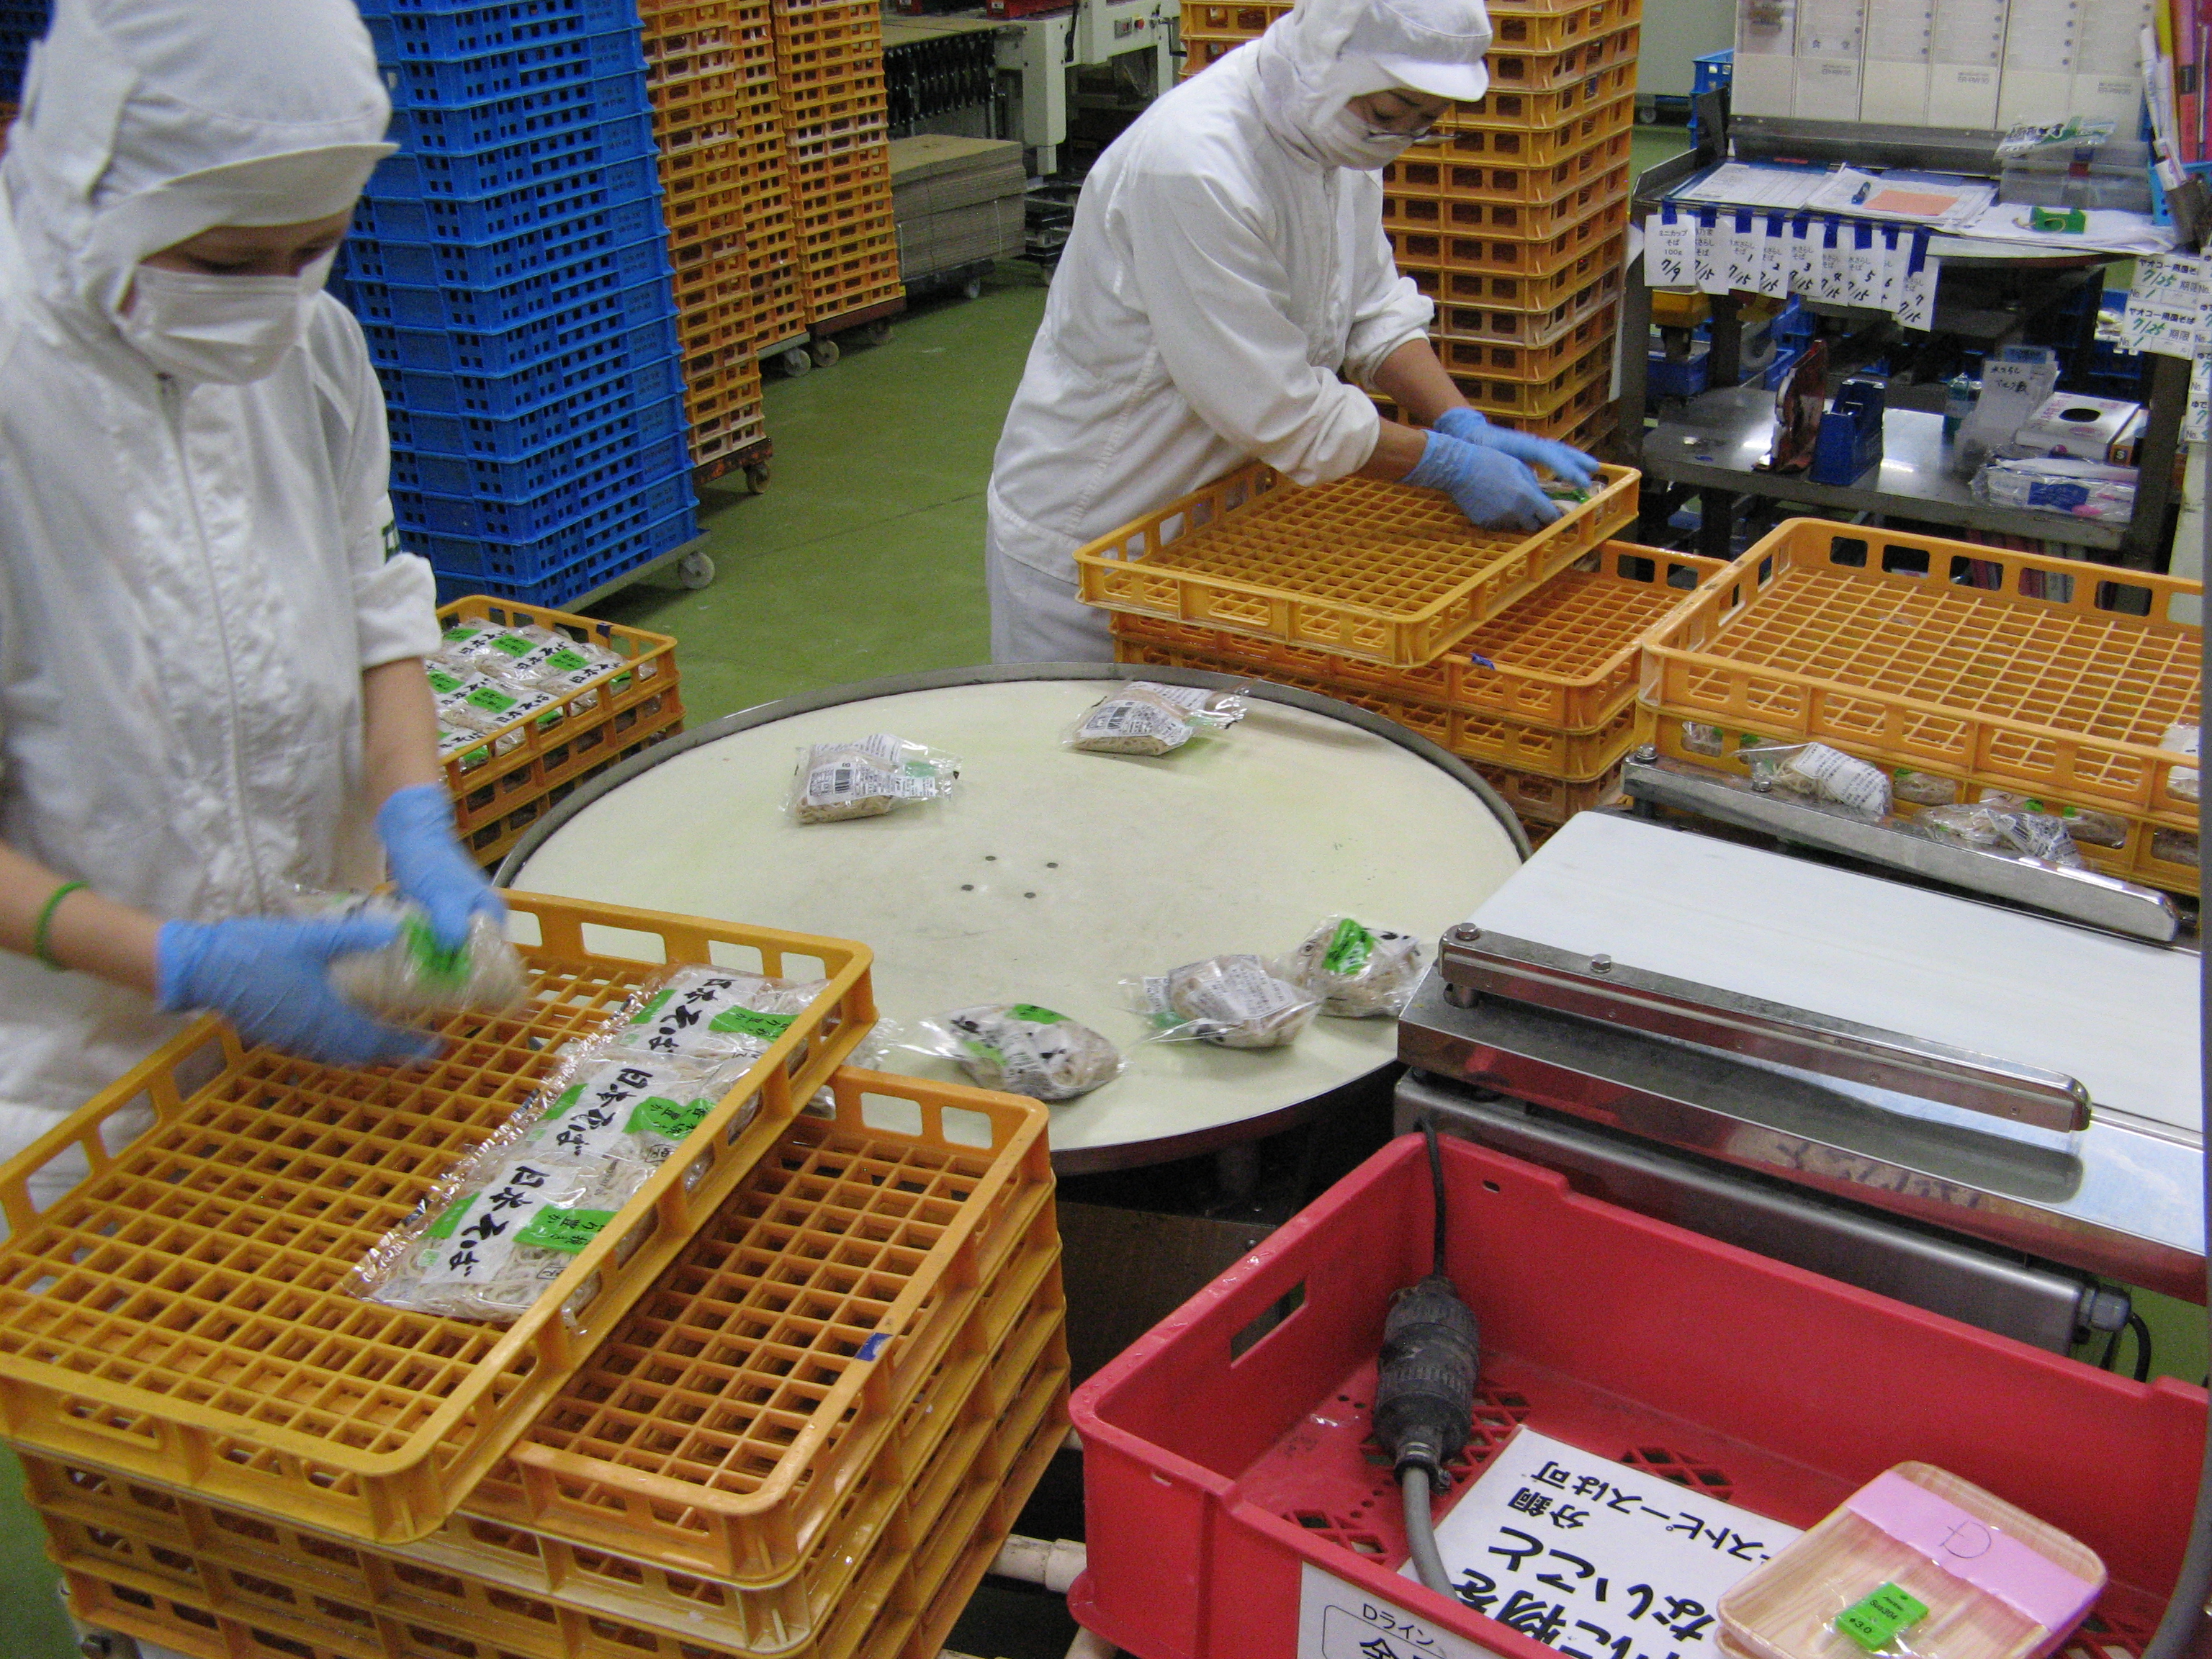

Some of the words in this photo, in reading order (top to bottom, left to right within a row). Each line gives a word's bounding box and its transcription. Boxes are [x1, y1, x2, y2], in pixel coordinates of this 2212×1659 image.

[1661, 258, 1681, 283] 7/9
[1729, 264, 1751, 285] 7/15
[1803, 262, 1812, 272] 3
[1864, 270, 1876, 282] 5
[1790, 270, 1814, 291] 7/15
[1821, 279, 1840, 300] 7/15
[1884, 278, 1893, 287] 6
[1848, 282, 1870, 302] 7/15
[1915, 294, 1925, 307] 7
[1897, 301, 1922, 323] 7/15
[449, 1166, 550, 1277] 日本そば
[1507, 1487, 1590, 1529] 分銅
[1531, 1461, 1772, 1565] ストピースは可
[1488, 1527, 1716, 1642] ないこと
[1363, 1604, 1434, 1645] Dライン
